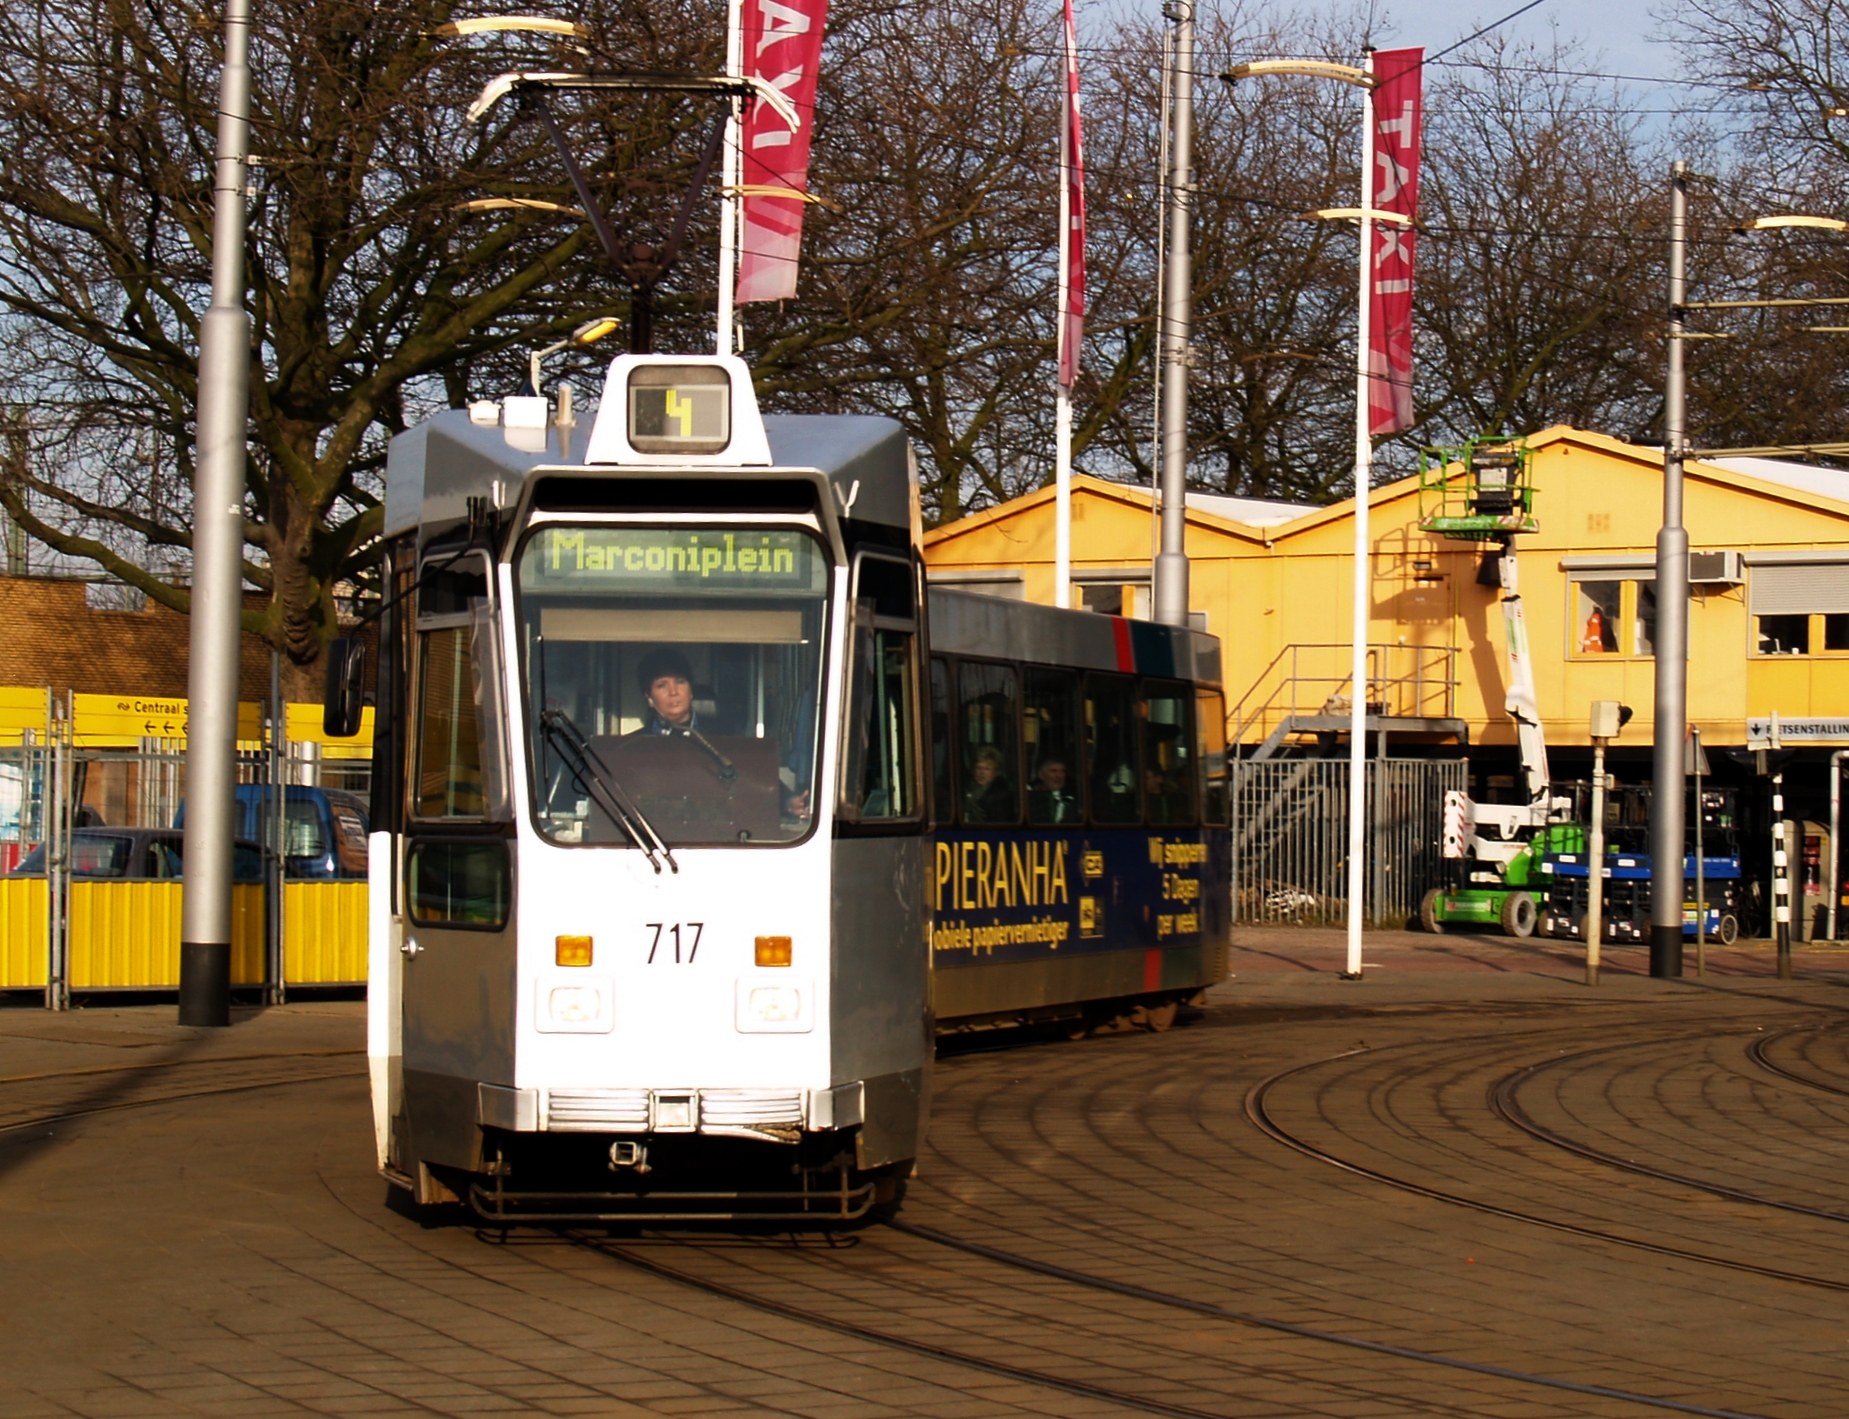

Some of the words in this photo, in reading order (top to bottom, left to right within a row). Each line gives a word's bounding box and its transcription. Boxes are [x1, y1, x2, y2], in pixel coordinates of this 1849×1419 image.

[1375, 99, 1414, 295] TAXI
[665, 389, 692, 437] 4
[552, 531, 794, 577] Marconiplein
[134, 700, 180, 714] Centraal
[1162, 872, 1171, 900] 5
[646, 922, 704, 964] 717
[926, 919, 972, 951] obiele
